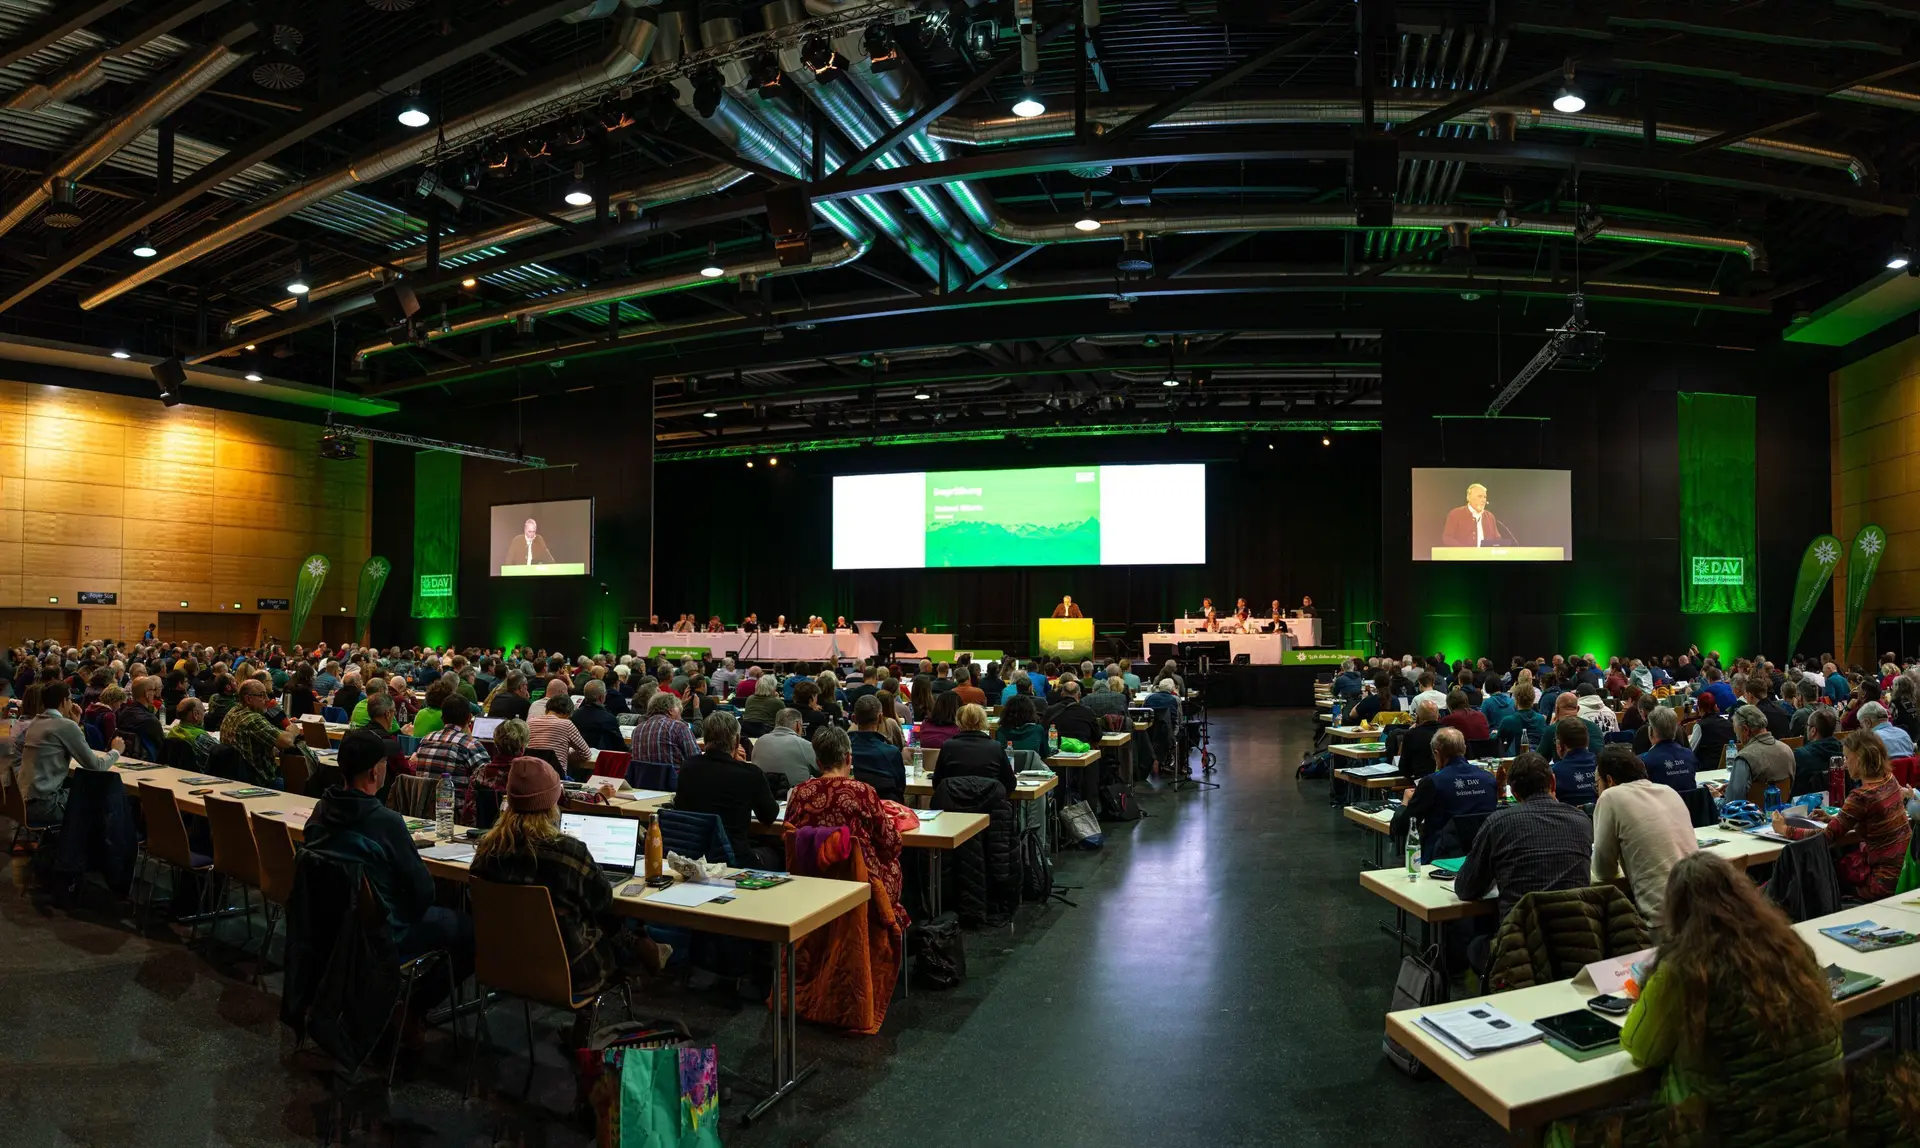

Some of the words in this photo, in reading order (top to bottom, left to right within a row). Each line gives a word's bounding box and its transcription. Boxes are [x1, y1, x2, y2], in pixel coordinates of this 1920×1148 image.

[1711, 561, 1740, 574] DAV
[431, 577, 449, 588] DAV
[1466, 778, 1480, 786] DAV
